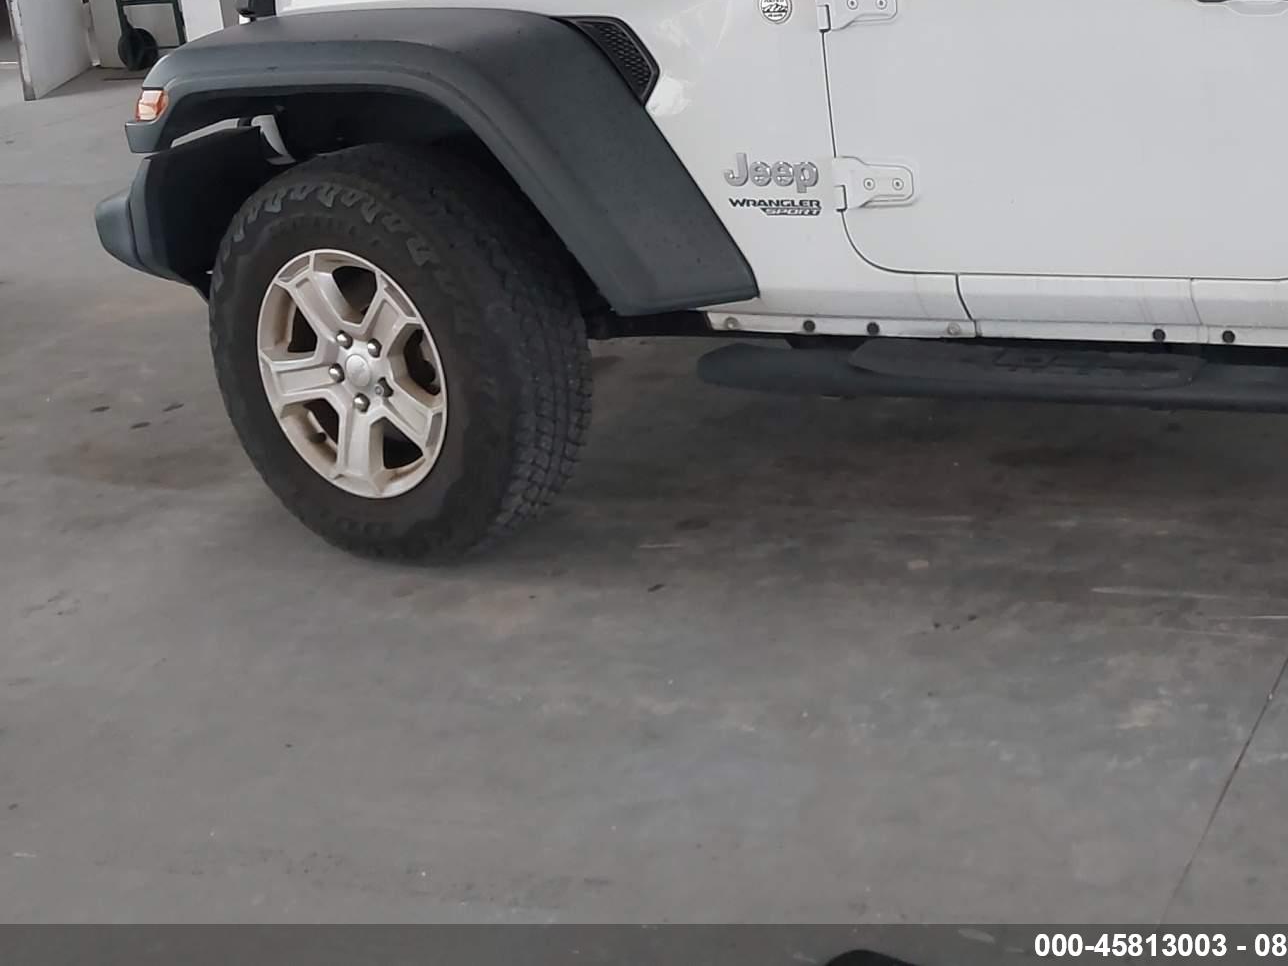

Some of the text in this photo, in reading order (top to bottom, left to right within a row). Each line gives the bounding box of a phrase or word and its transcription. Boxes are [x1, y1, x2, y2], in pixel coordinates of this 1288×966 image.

[723, 152, 819, 194] Jeep
[728, 198, 822, 208] WRANGLER
[763, 207, 821, 216] SPORT
